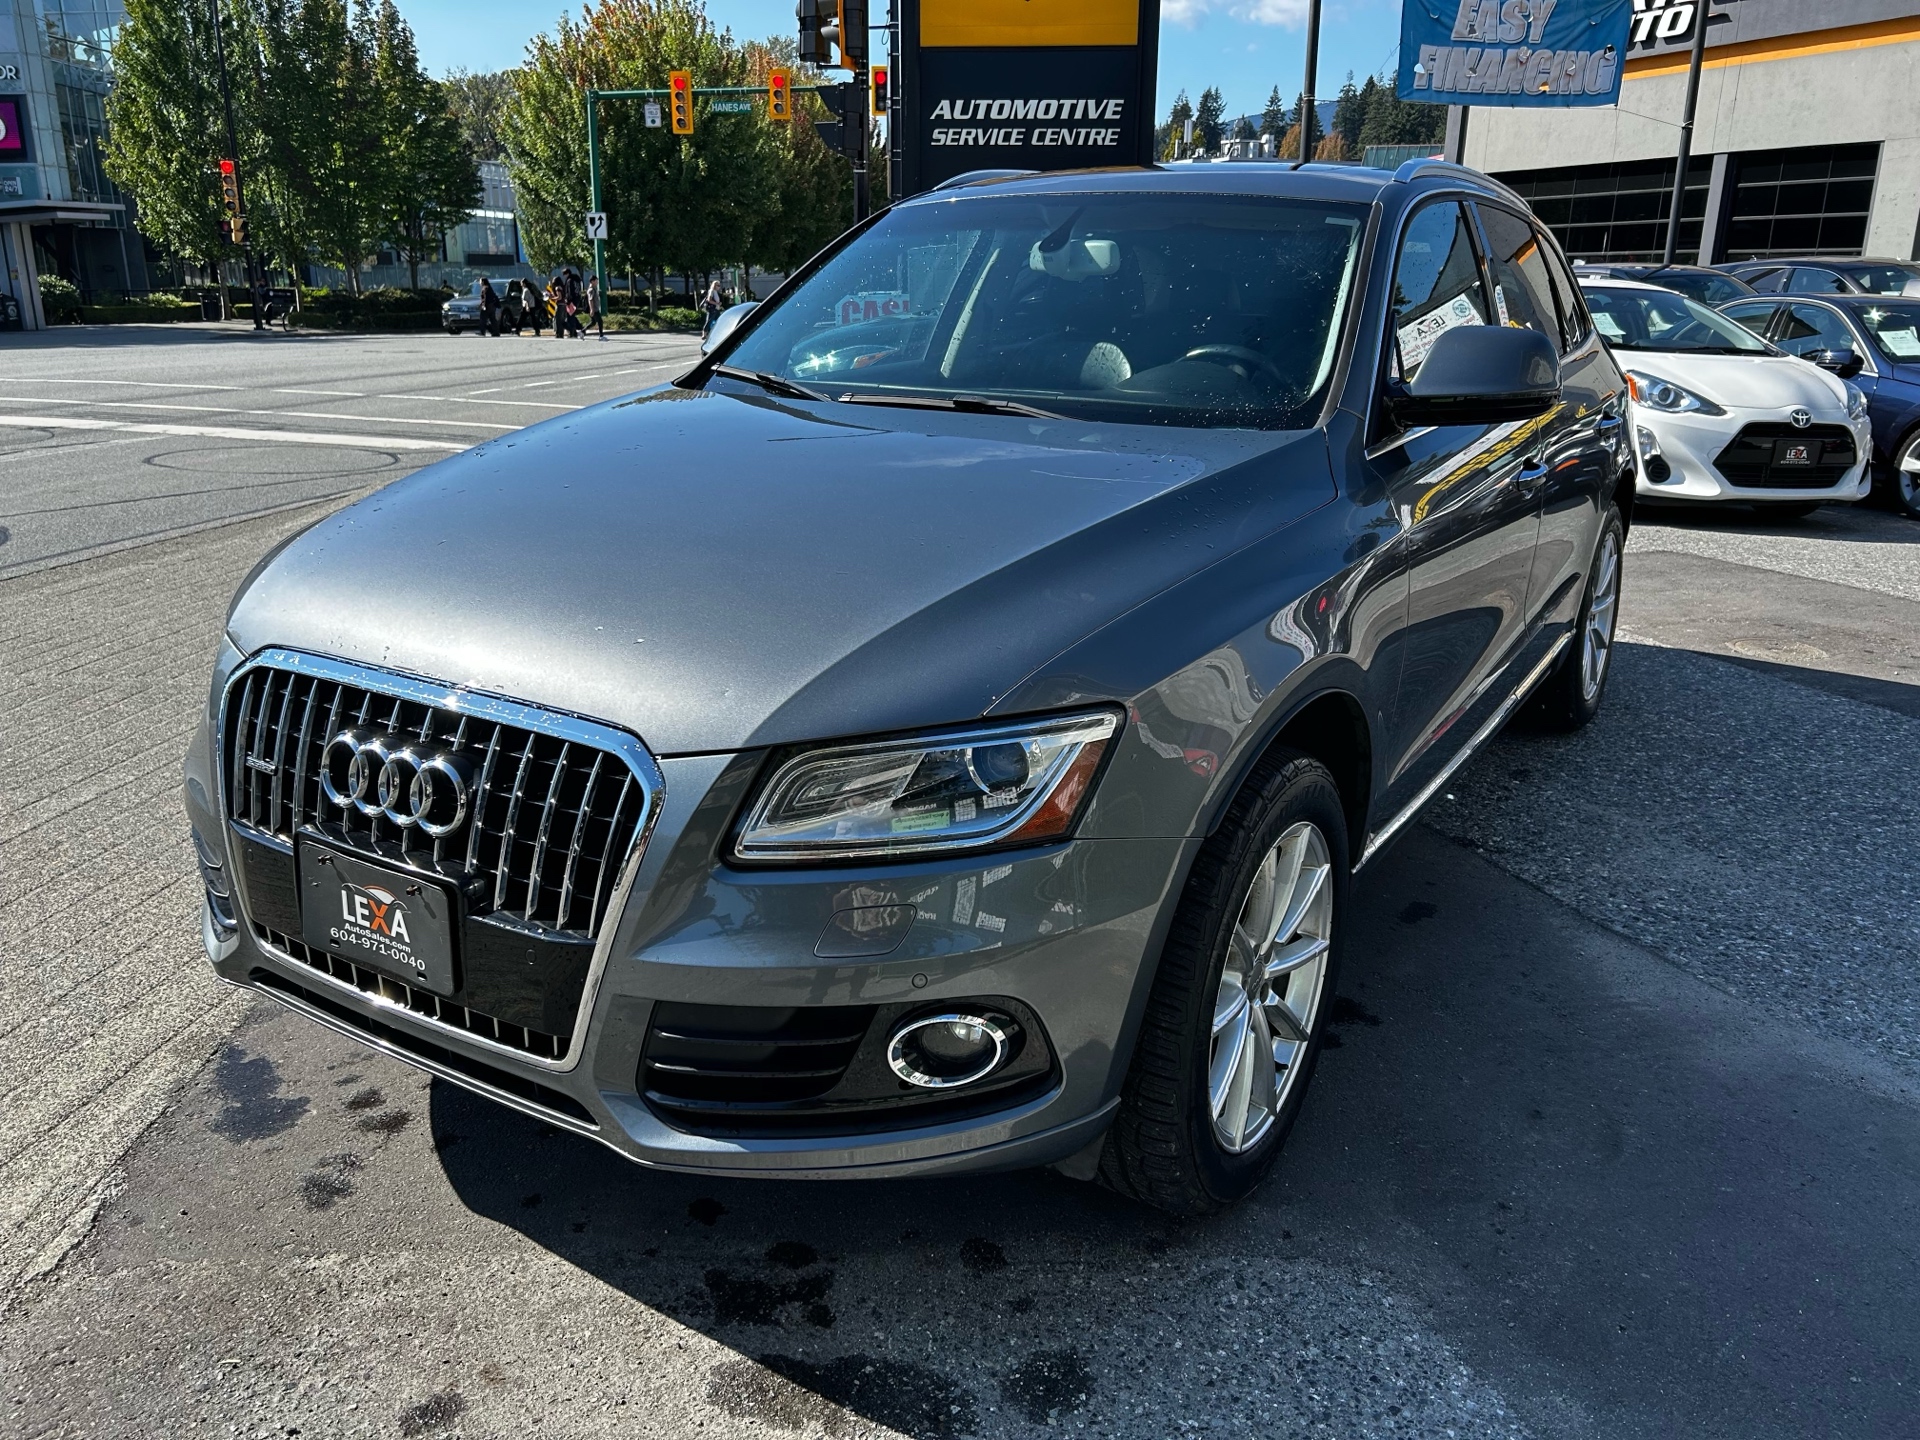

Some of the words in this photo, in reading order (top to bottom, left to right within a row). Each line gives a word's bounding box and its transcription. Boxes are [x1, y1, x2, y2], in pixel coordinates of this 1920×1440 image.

[1451, 0, 1557, 44] EASY
[1413, 44, 1618, 95] FINANCING
[711, 103, 739, 112] HANES
[739, 103, 752, 111] AVE
[930, 99, 1125, 120] AUTOMOTIVE
[930, 128, 1026, 146] SERVICE
[1031, 128, 1121, 146] CENTRE
[1786, 449, 1808, 459] LEXA
[341, 889, 411, 944] LEXA
[330, 927, 426, 971] 604-971-0040
[344, 922, 411, 953] AutoSales.com
